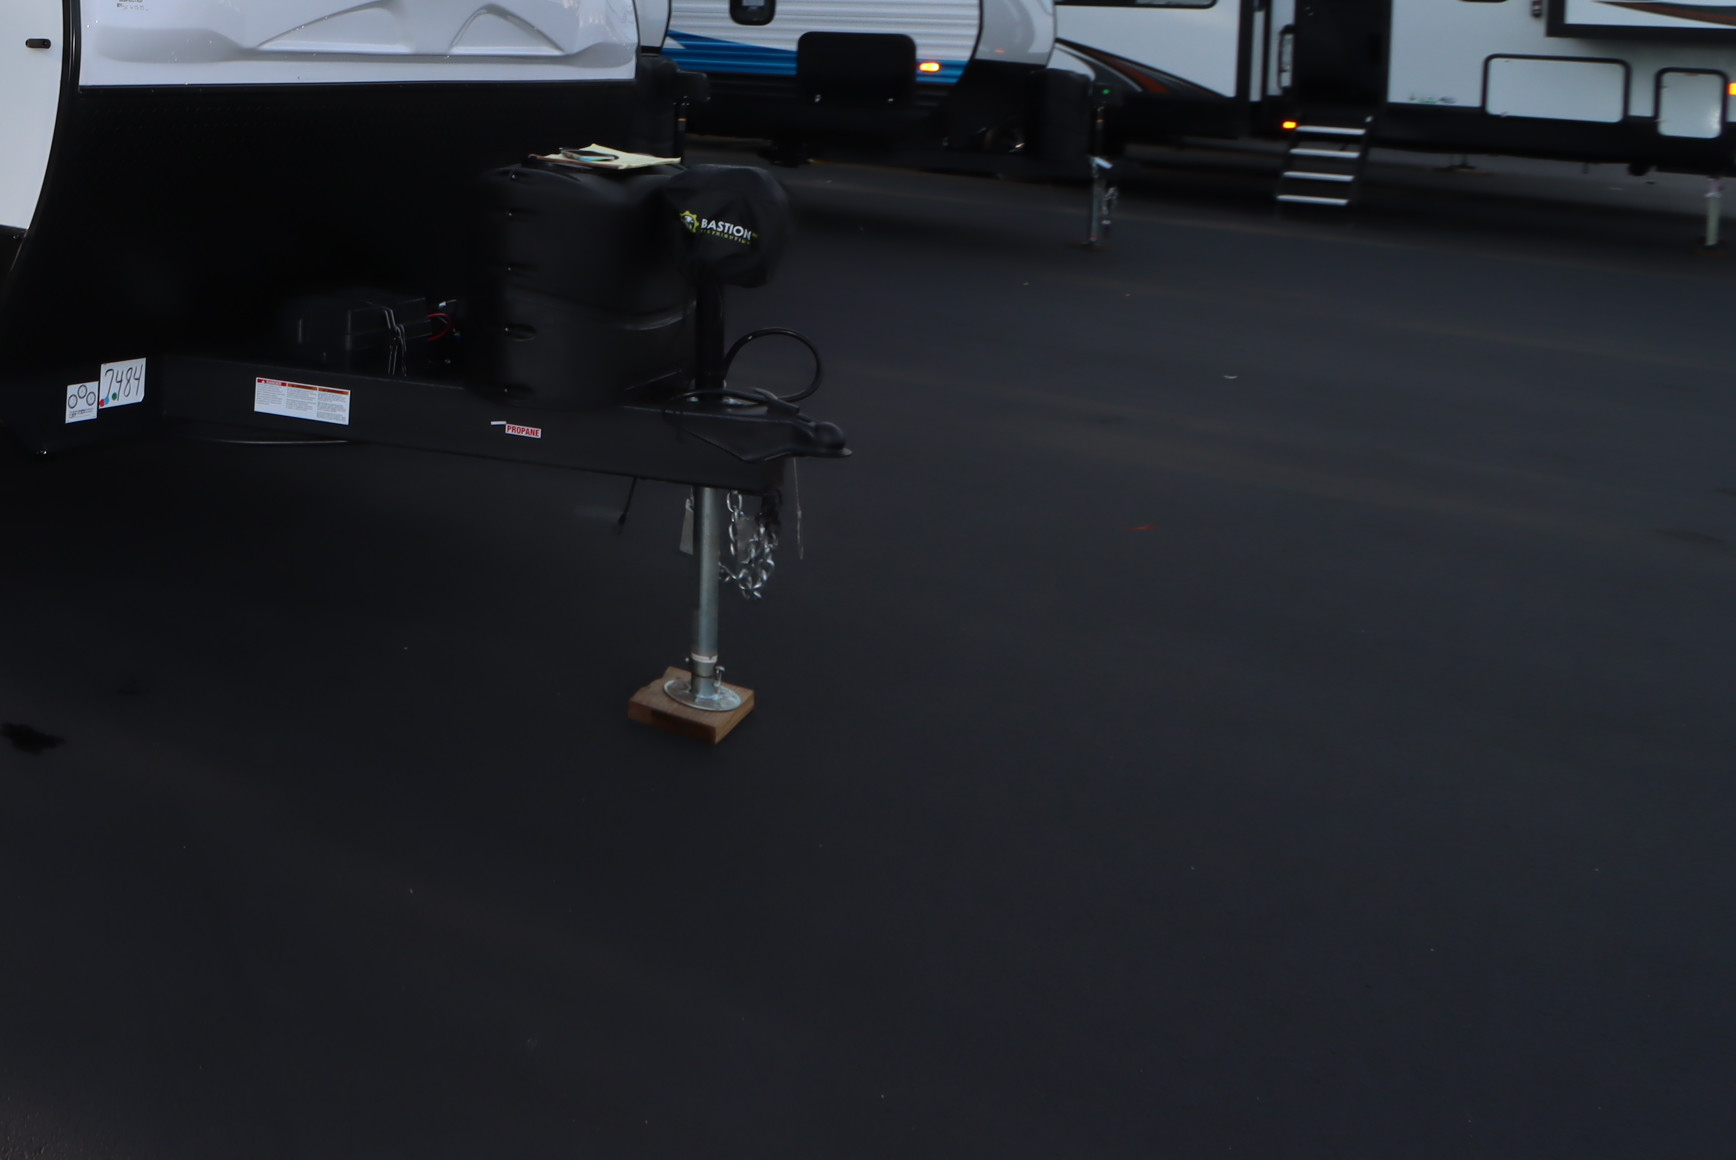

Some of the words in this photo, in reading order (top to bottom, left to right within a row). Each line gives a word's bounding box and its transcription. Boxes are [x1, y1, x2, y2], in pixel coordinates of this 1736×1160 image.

[700, 218, 752, 241] BASTION
[104, 364, 144, 402] 7484
[506, 425, 541, 437] PROPANE
